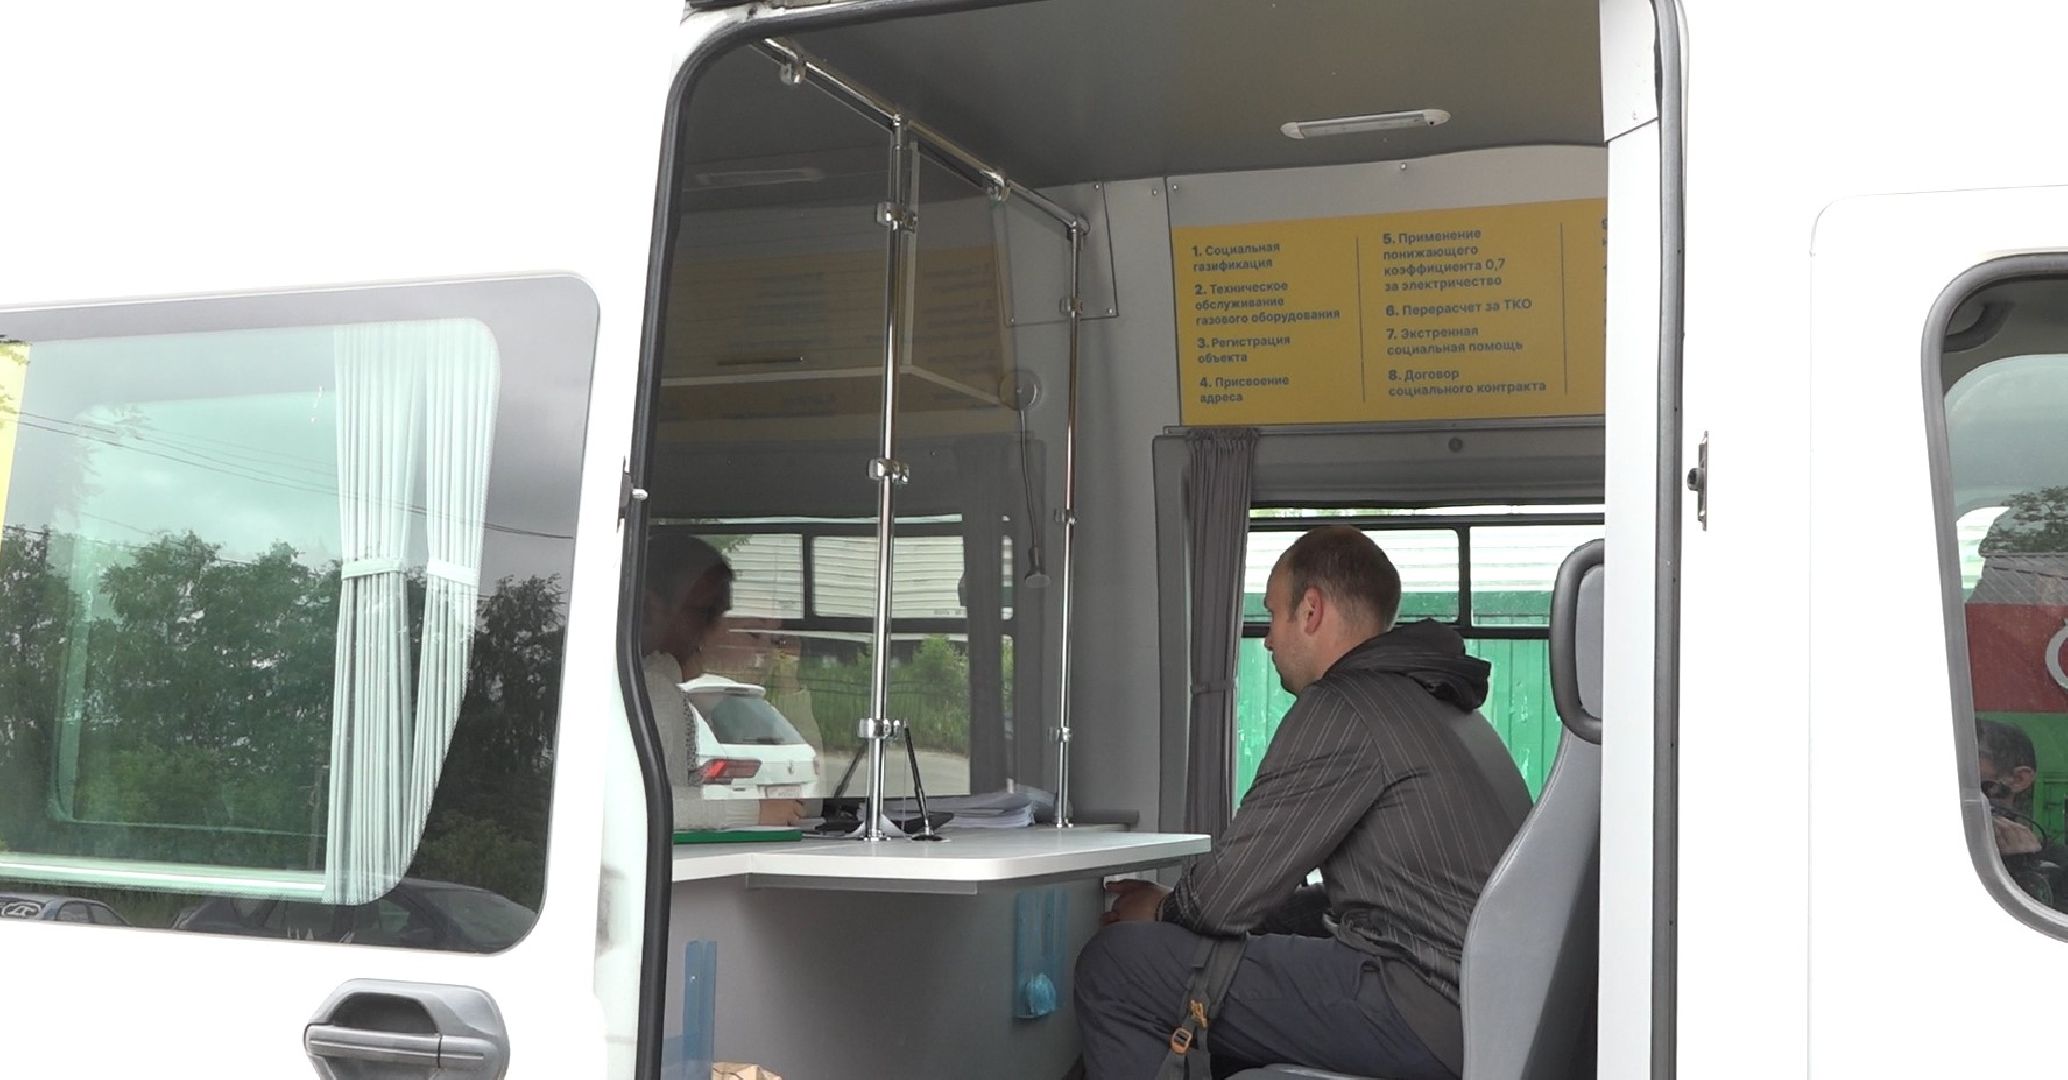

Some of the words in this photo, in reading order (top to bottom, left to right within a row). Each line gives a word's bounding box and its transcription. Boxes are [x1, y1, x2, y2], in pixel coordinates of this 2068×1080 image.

[1382, 233, 1395, 244] 5.
[1398, 228, 1481, 245] Применение
[1192, 245, 1202, 257] 1.
[1204, 242, 1280, 257] Социальная
[1383, 245, 1478, 260] понижающего
[1193, 258, 1273, 272] газификация
[1384, 261, 1482, 277] коэффициента
[1485, 258, 1506, 272] 0,7
[1195, 284, 1207, 295] 2.
[1210, 281, 1288, 294] Техническое
[1384, 282, 1399, 292] за
[1401, 276, 1502, 291] электричество
[1195, 297, 1284, 312] обслуживание
[1385, 305, 1399, 316] 6.
[1402, 302, 1482, 317] Перерасчет
[1485, 302, 1500, 312] за
[1504, 298, 1532, 310] ТКО
[1196, 314, 1248, 326] газового
[1251, 309, 1340, 324] оборудования
[1386, 328, 1397, 340] 7.
[1401, 326, 1479, 340] Экстренная
[1197, 337, 1209, 349] 3.
[1211, 335, 1290, 348] Регистрация
[1387, 342, 1466, 356] социальная
[1469, 340, 1523, 353] помощь
[1197, 352, 1247, 364] объекта
[1199, 377, 1211, 388] 4.
[1215, 375, 1289, 389] Присвоение
[1388, 369, 1402, 381] 8.
[1404, 368, 1459, 383] Договор
[1388, 384, 1474, 398] социального
[1476, 381, 1547, 395] контракта
[1200, 393, 1243, 405] адреса
